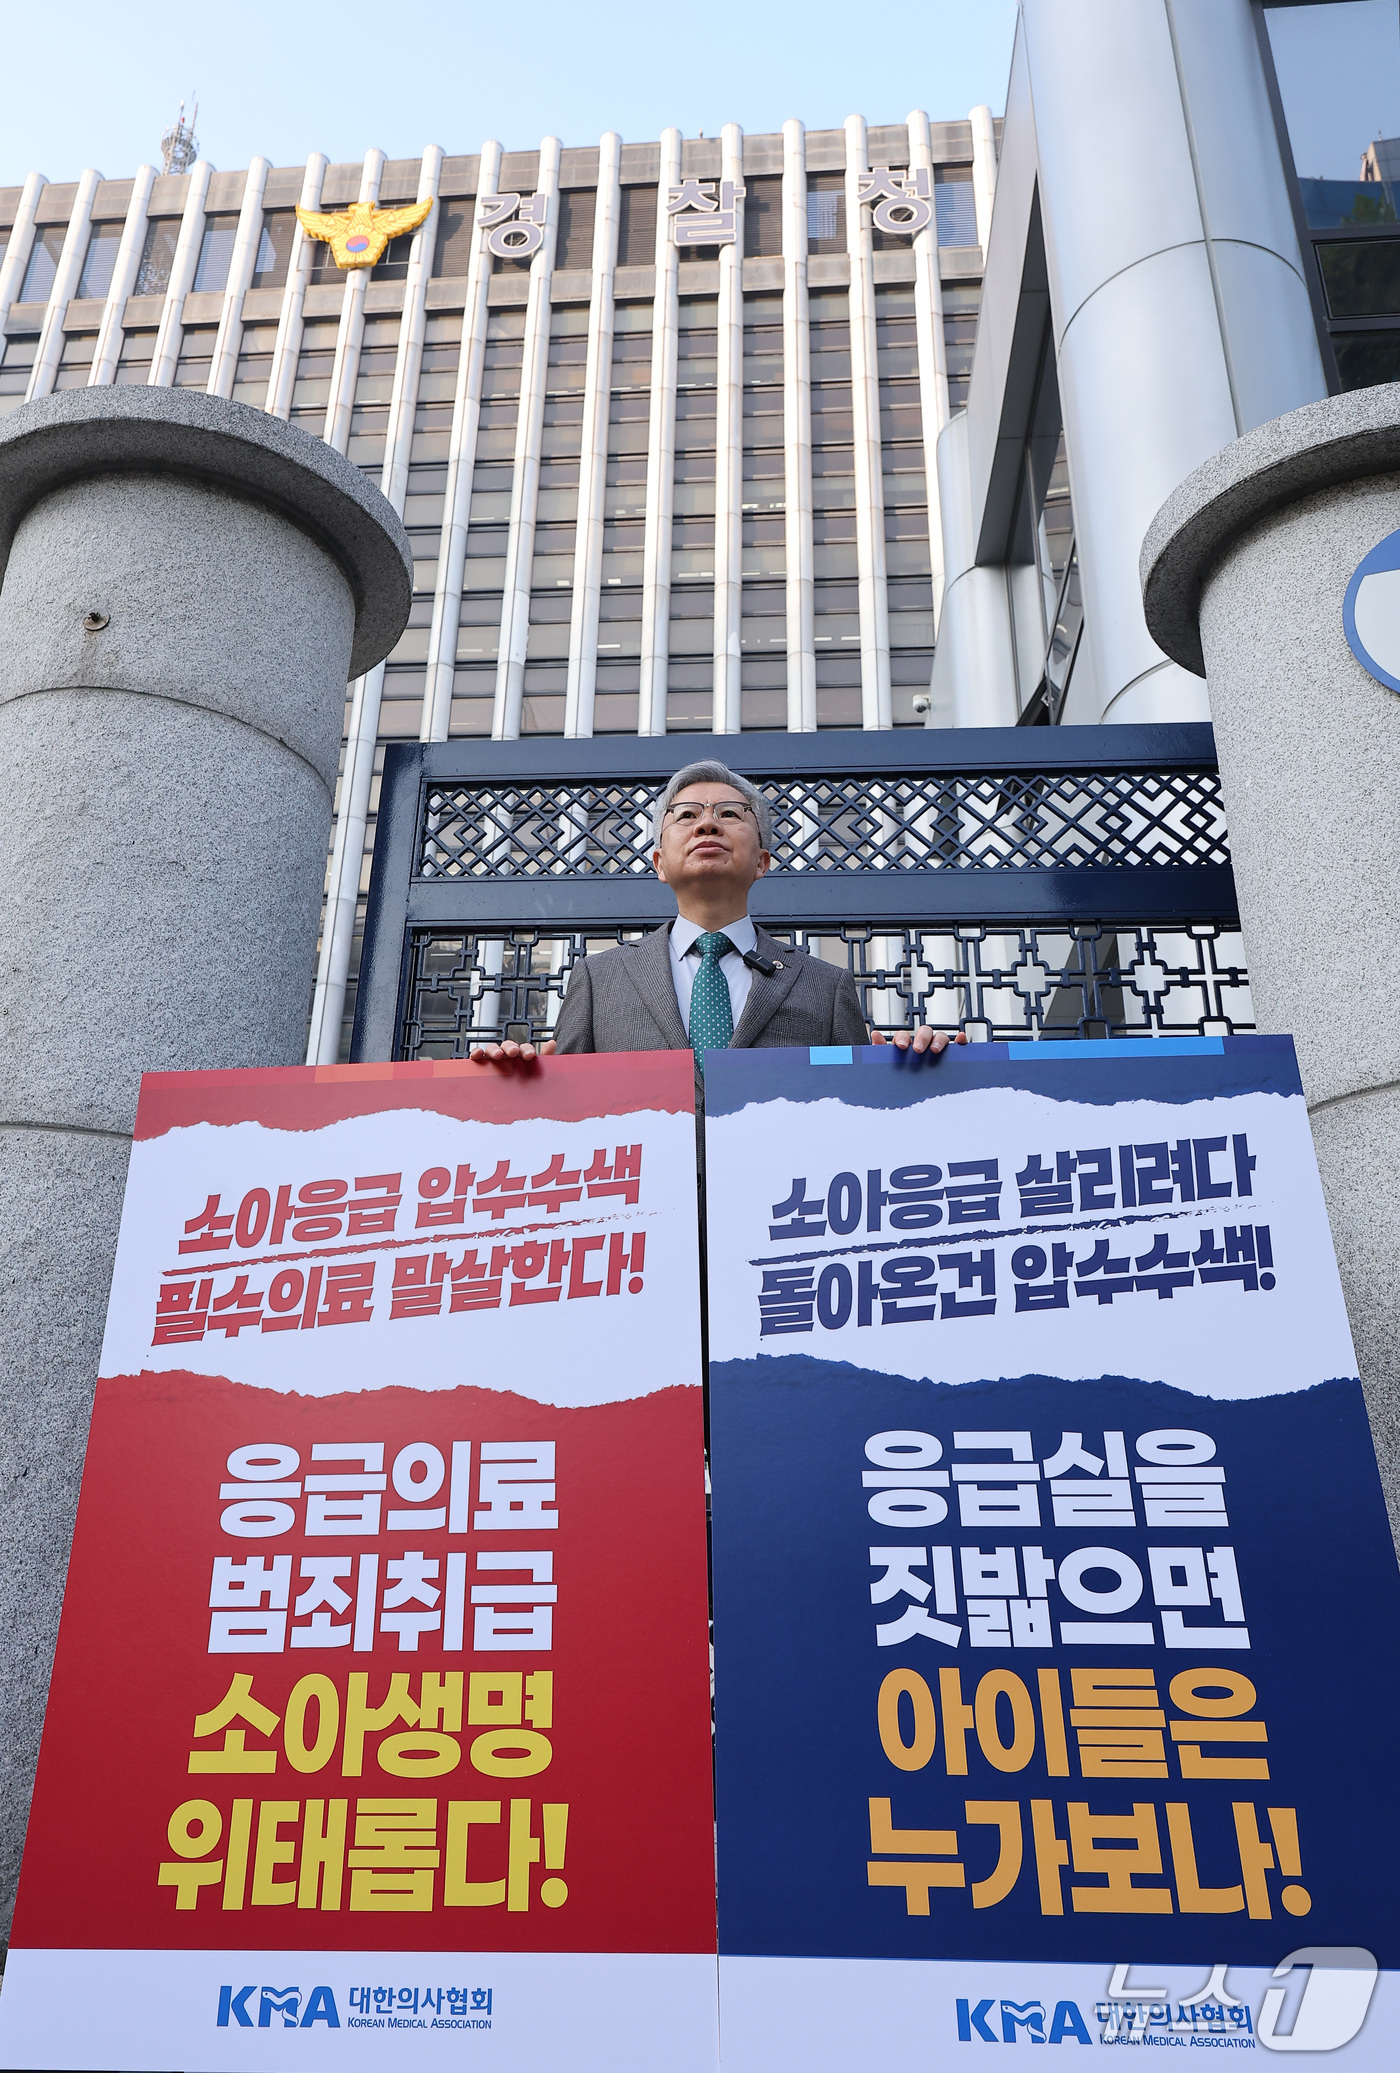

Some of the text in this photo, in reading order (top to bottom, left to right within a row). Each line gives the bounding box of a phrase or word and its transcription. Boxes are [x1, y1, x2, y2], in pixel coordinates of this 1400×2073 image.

[477, 166, 933, 258] 경찰청
[178, 1143, 643, 1255] 소아응급 압수수색
[768, 1133, 1257, 1241] 소아응급 살리려다
[151, 1231, 647, 1347] 필수의료 말살한다!
[757, 1225, 1277, 1337] 돌아온건 압수수색!
[218, 1440, 560, 1539] 응급의료
[861, 1428, 1230, 1528] 응급실을
[207, 1550, 558, 1654] 범죄취급
[868, 1545, 1252, 1649] 짓밟으면
[187, 1670, 554, 1779] 소아생명
[877, 1667, 1271, 1780] 아이들은
[157, 1798, 570, 1912] 위태롭다!
[866, 1797, 1312, 1920] 누가보나!
[216, 1985, 341, 2028] KMA
[349, 1986, 493, 2015] 대한의사협회
[955, 1998, 1093, 2045] KMA
[1096, 2002, 1254, 2034] 대한의사협회
